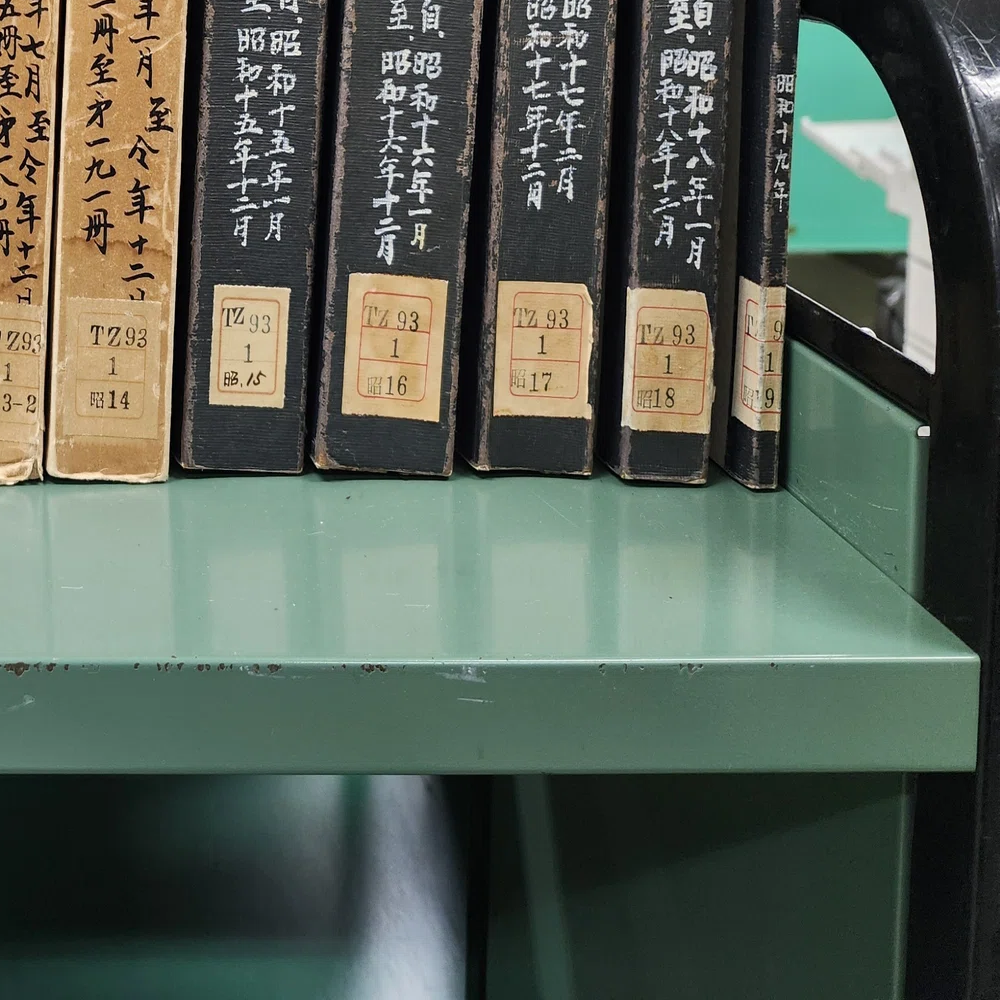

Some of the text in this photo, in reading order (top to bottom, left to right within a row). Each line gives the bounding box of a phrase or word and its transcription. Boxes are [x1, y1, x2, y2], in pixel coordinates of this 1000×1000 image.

[243, 344, 253, 363] 1
[390, 338, 399, 358] 1
[537, 335, 547, 355] 1
[108, 356, 118, 375] 1
[663, 354, 673, 374] 1
[764, 352, 774, 372] 1
[3, 363, 12, 382] 1
